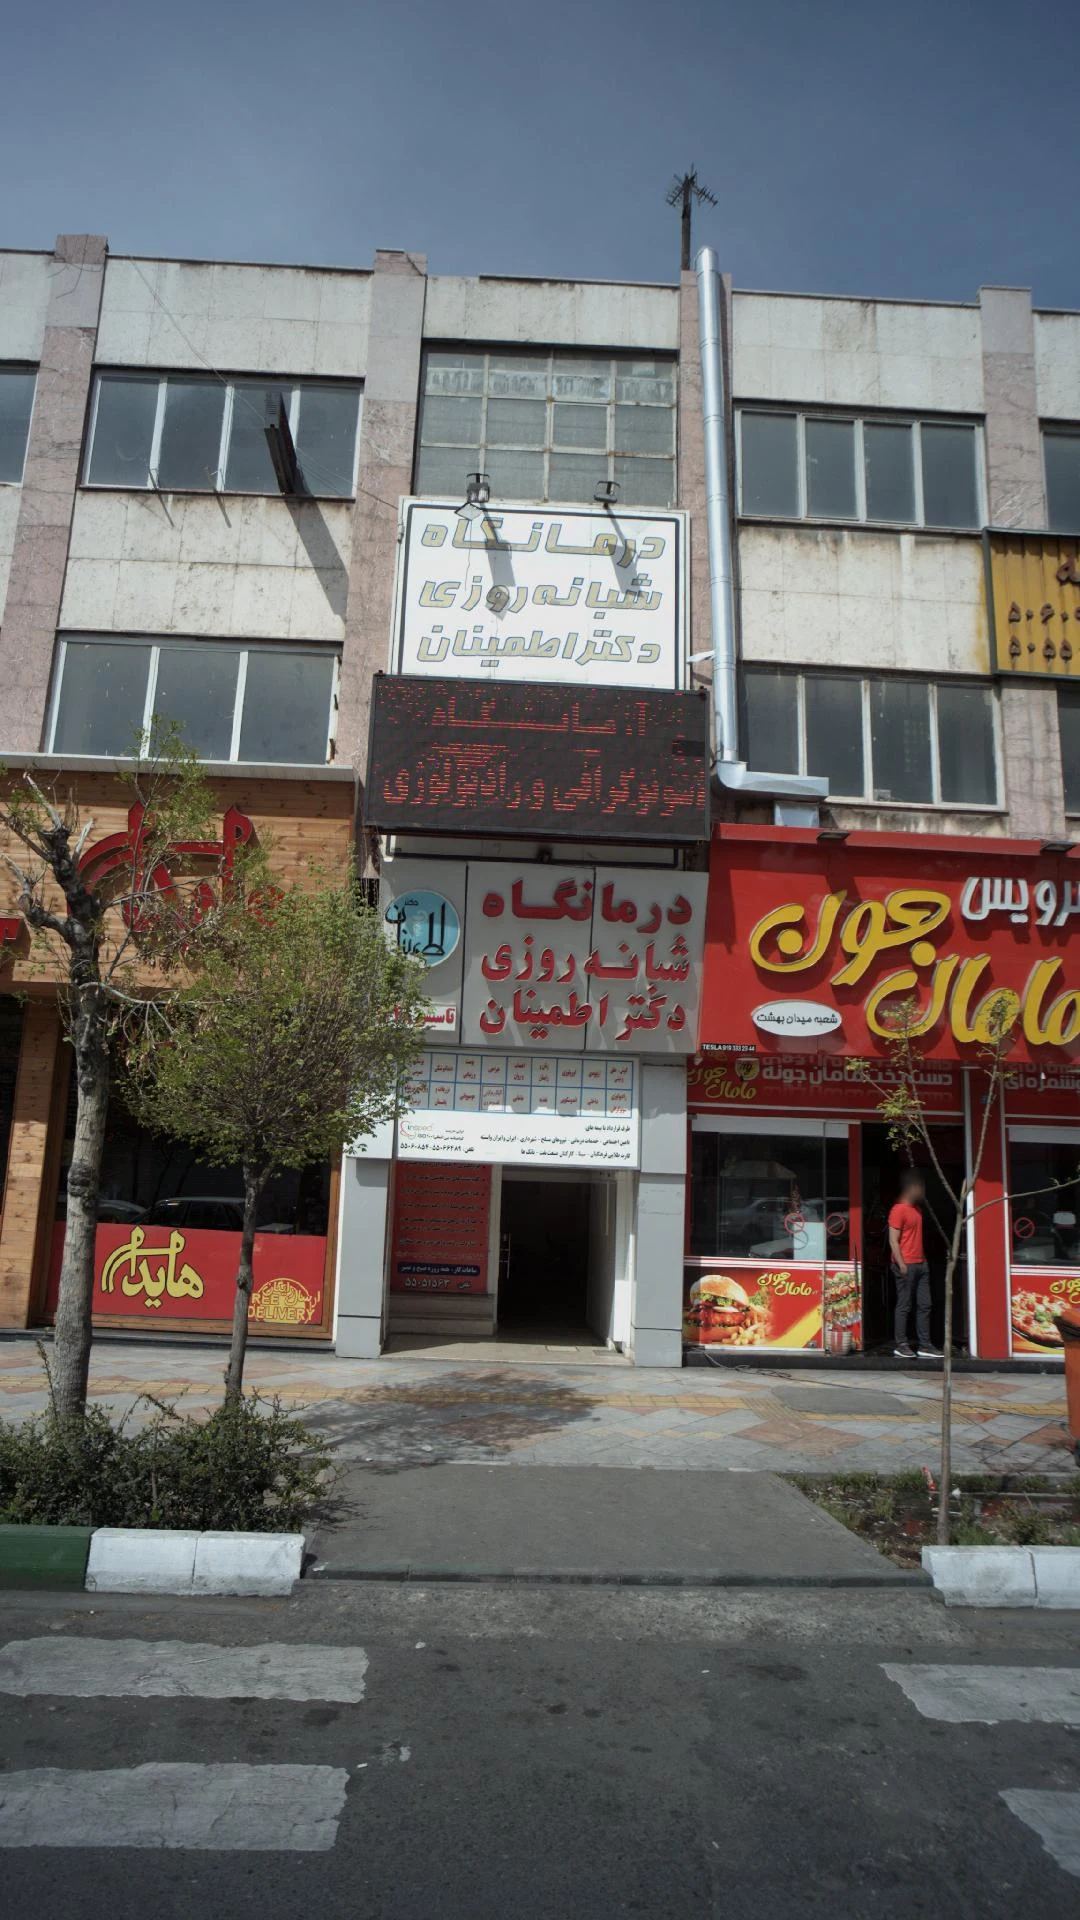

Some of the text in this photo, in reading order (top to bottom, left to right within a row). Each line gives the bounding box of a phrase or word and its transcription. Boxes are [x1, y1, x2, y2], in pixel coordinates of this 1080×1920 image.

[421, 517, 666, 568] درمانگاه
[416, 625, 662, 668] دکتر اطمینان
[481, 879, 693, 933] درمانگاه
[750, 889, 951, 986] جون
[479, 988, 687, 1041] دکتر اطمینان
[757, 1011, 838, 1025] شعبه میدان بهشت
[757, 1272, 791, 1286] جون
[774, 1279, 813, 1296] مامان
[248, 1304, 315, 1321] DELIVERY
[251, 1292, 279, 1306] REE
